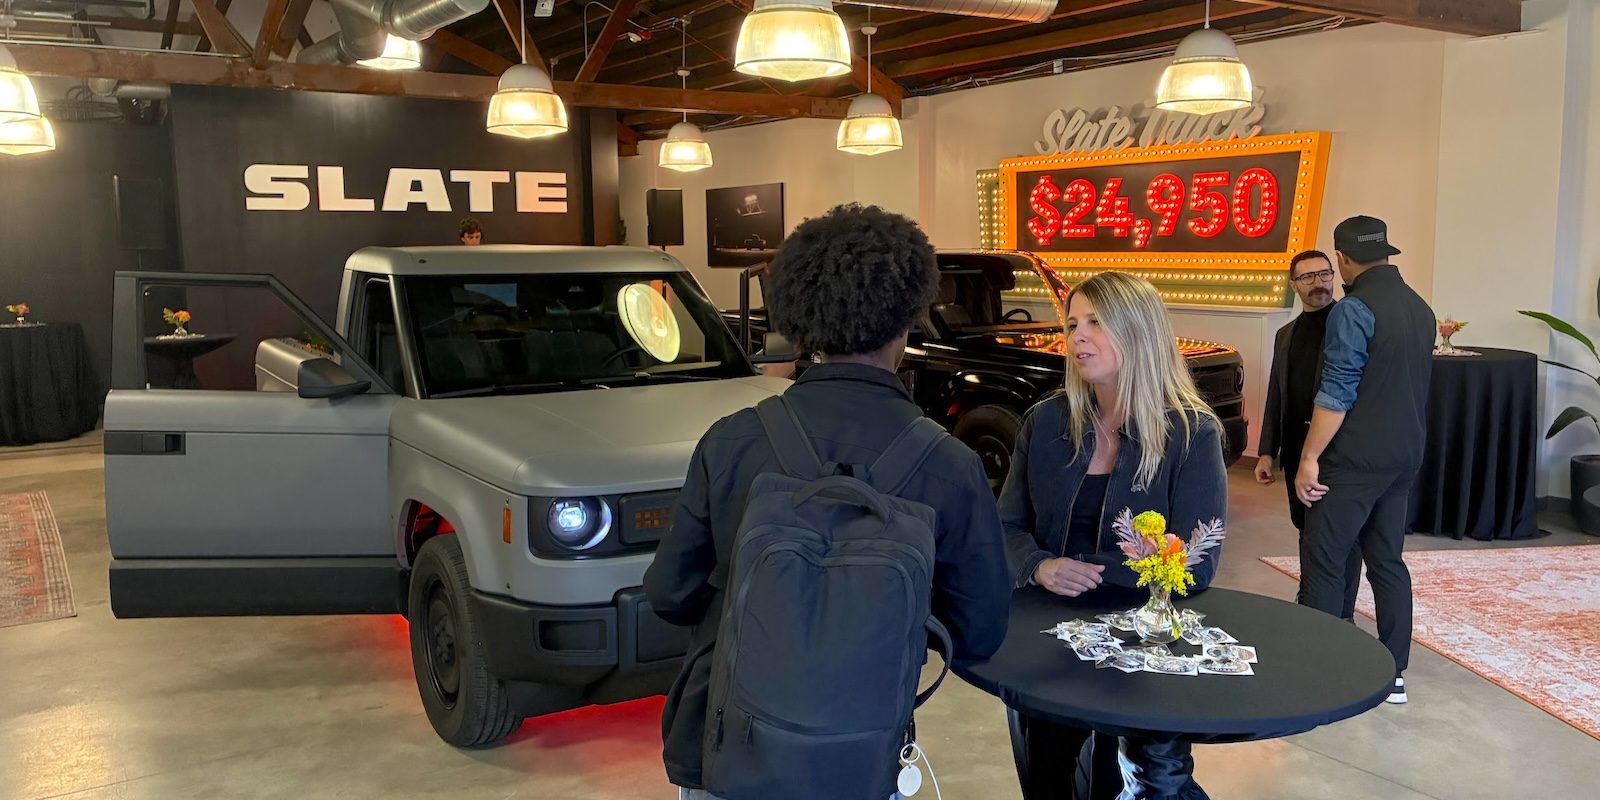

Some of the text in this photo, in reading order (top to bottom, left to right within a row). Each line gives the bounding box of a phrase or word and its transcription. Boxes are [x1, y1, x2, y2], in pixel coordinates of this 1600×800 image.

[1034, 105, 1135, 156] Slate
[244, 164, 567, 213] SLATE
[1028, 168, 1278, 248] $24,950
